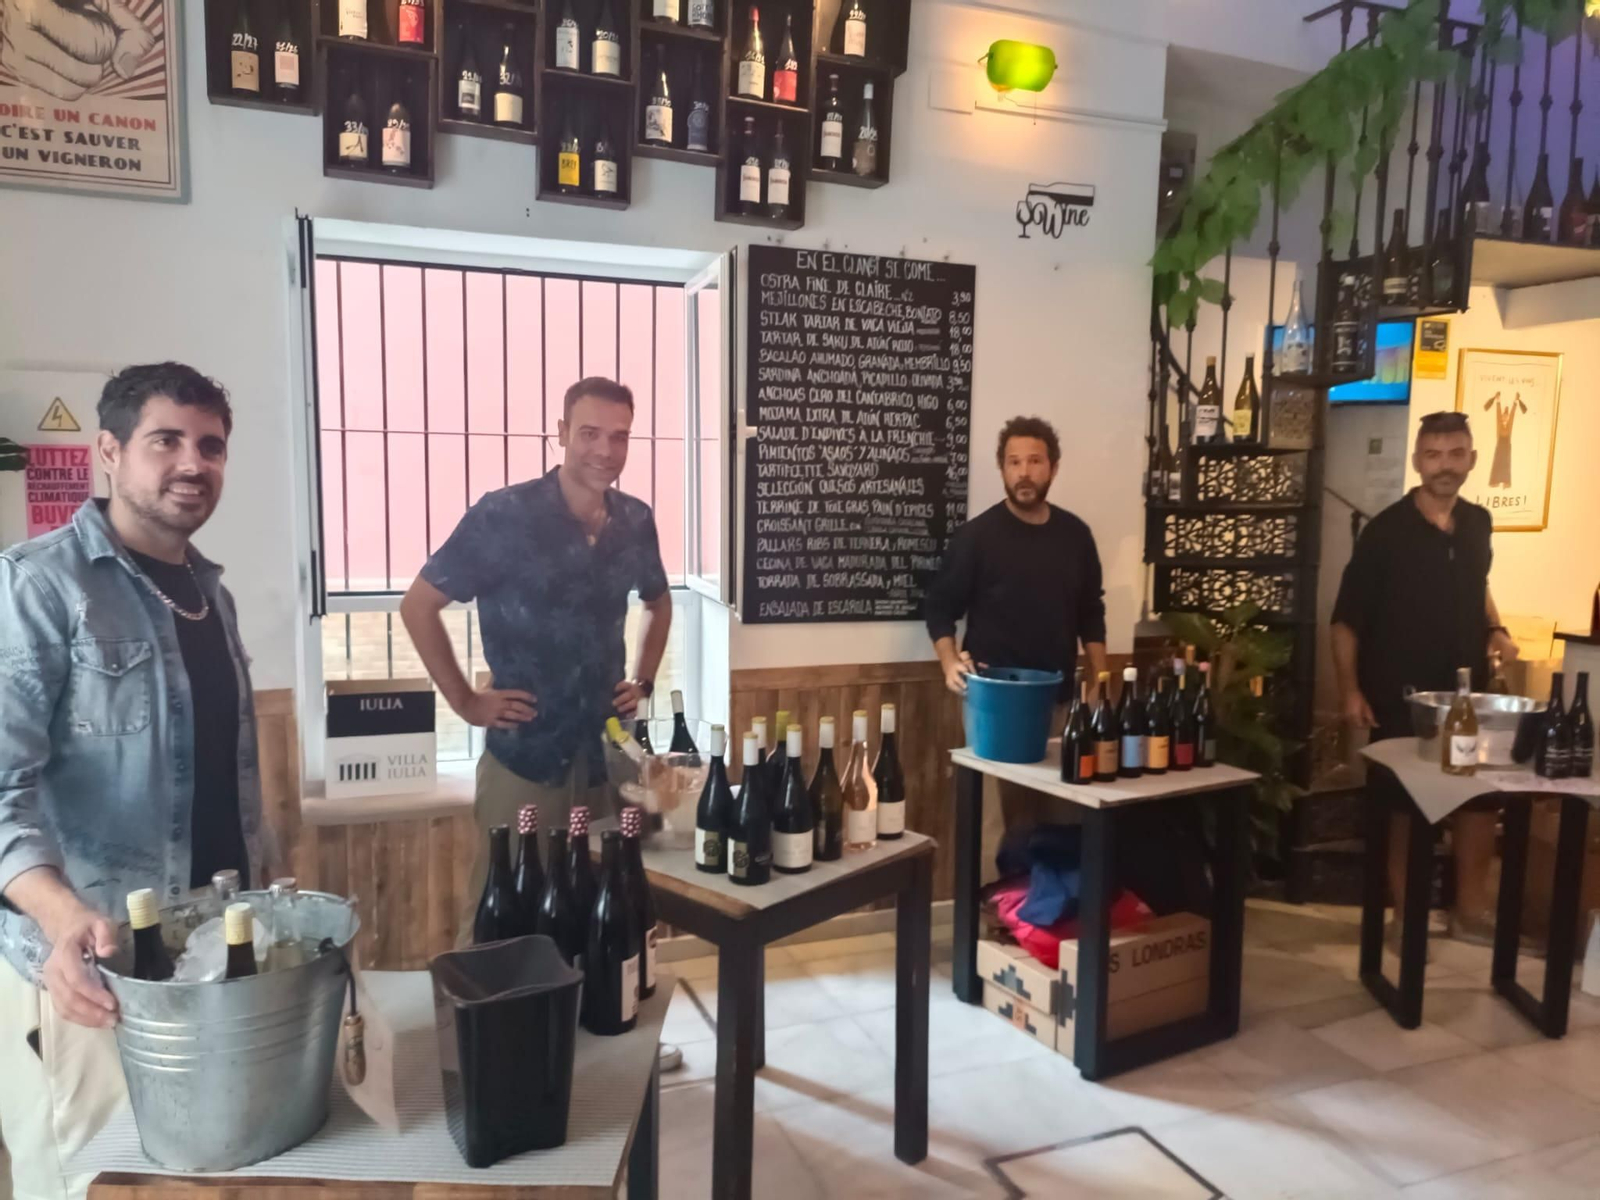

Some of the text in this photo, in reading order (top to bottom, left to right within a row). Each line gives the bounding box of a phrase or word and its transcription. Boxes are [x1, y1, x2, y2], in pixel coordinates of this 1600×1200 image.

[53, 109, 80, 123] UN
[89, 113, 156, 131] CANON
[1, 123, 141, 150] C'EST SAUVER
[2, 147, 142, 172] UN VIGNERON
[797, 250, 817, 270] EN
[822, 254, 840, 273] EL
[760, 273, 800, 290] OSTRA
[806, 276, 831, 293] FINE
[836, 280, 850, 295] DE
[761, 290, 827, 310] MEJILLONES
[831, 297, 846, 312] EN
[760, 310, 797, 327] STEAK
[802, 314, 840, 331] TARTAR
[845, 317, 858, 331] DE
[861, 318, 884, 333] VACA
[887, 320, 914, 335] VIEJA
[760, 331, 803, 347] TARTAR
[806, 333, 819, 346] DE
[822, 333, 848, 349] SAKU
[849, 335, 864, 349] DE
[759, 348, 806, 364] BACALAO
[758, 366, 802, 382] SARDINA
[758, 386, 805, 402] ANCHOAS
[836, 390, 853, 404] DEL
[917, 394, 938, 410] HIGO
[759, 406, 802, 422] MOJAMA
[806, 407, 837, 424] EXTRA
[841, 409, 854, 424] DE
[757, 425, 798, 442] SALADE
[871, 430, 884, 443] LA
[759, 443, 815, 461] PIMIENTOS
[26, 468, 89, 480] CONTRE LE
[819, 479, 856, 494] QUESOS
[31, 505, 77, 524] BUV
[756, 499, 804, 515] TERRINE
[807, 500, 820, 514] DE
[757, 517, 811, 534] CROISSANT
[834, 537, 847, 550] DE
[795, 556, 807, 569] DE
[756, 574, 801, 589] TORRADA
[806, 573, 821, 589] DE
[812, 601, 824, 616] DE
[360, 698, 403, 711] IULIA
[387, 754, 428, 766] VILLA
[388, 767, 426, 780] IULIA
[1131, 931, 1206, 967] LONDRAS
